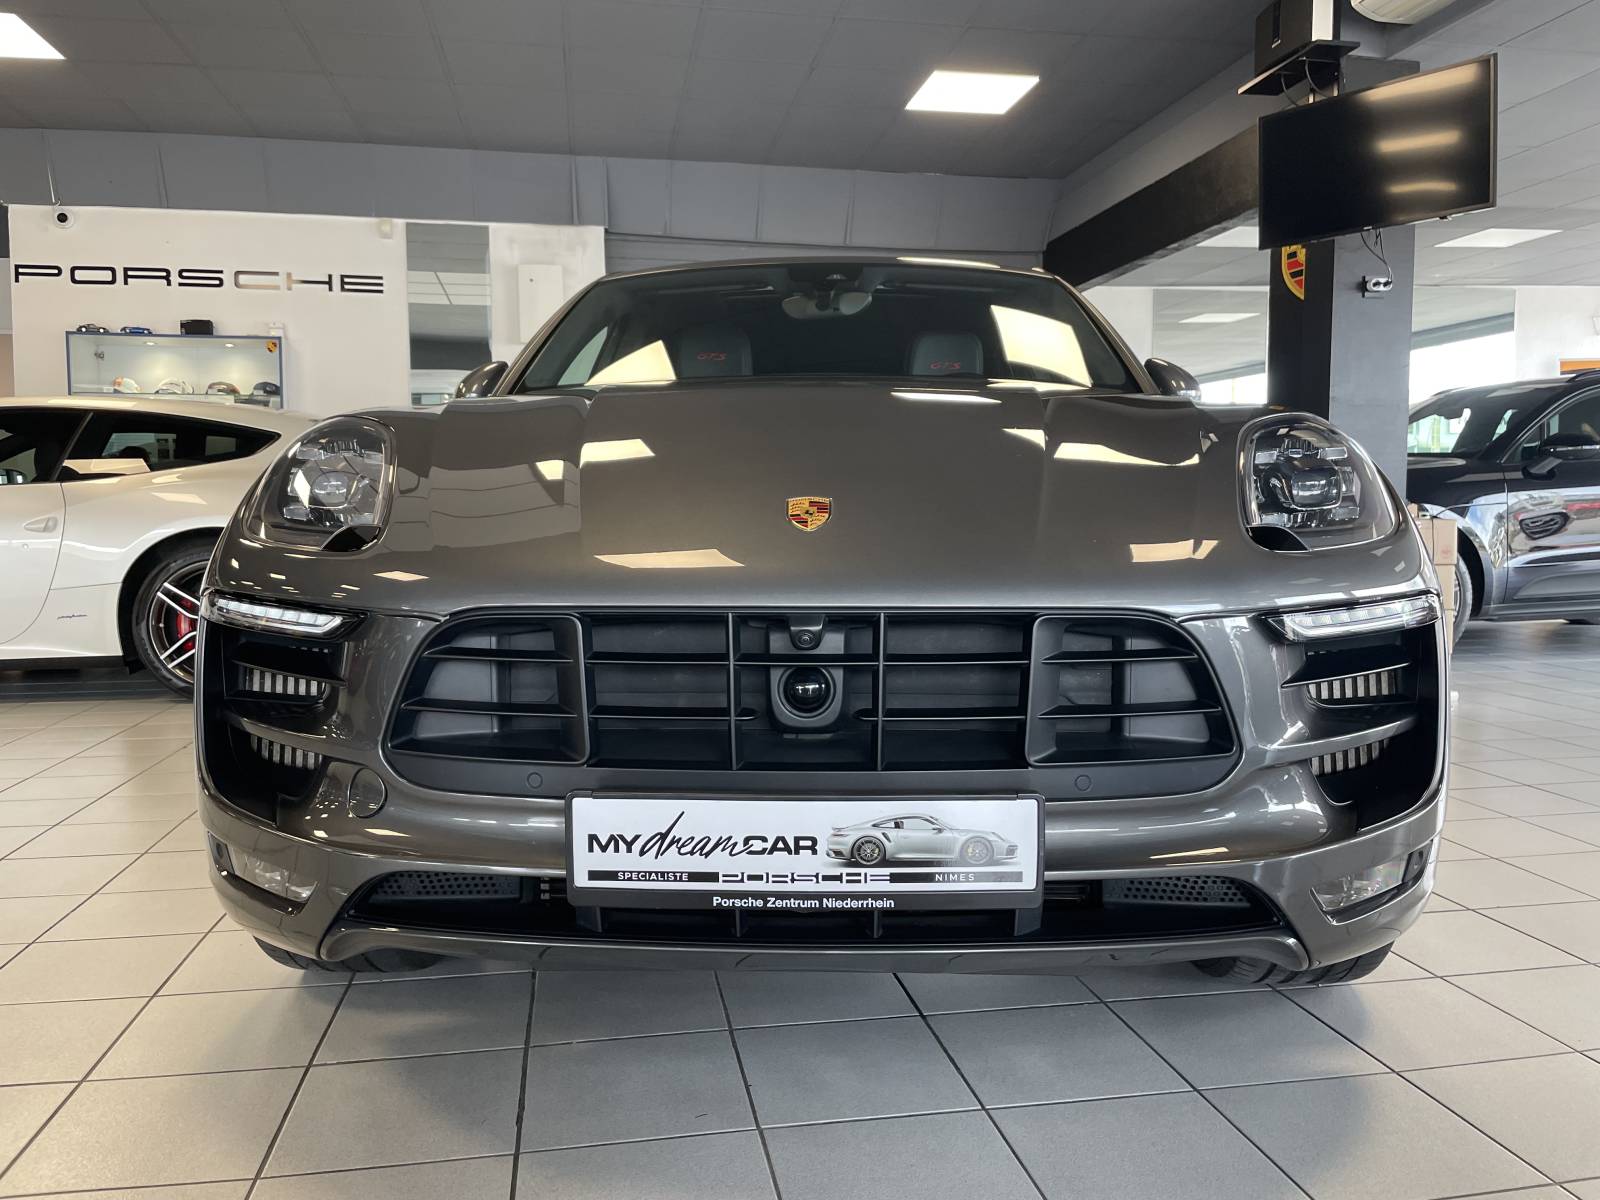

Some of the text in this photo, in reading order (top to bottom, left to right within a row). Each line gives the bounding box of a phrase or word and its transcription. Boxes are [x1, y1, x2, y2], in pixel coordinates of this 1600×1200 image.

[14, 264, 384, 294] PORSCHE
[617, 871, 975, 884] SPECIALISTE PORSCHE NIMES
[712, 896, 895, 909] Porsche Zentrum Niederrhein
